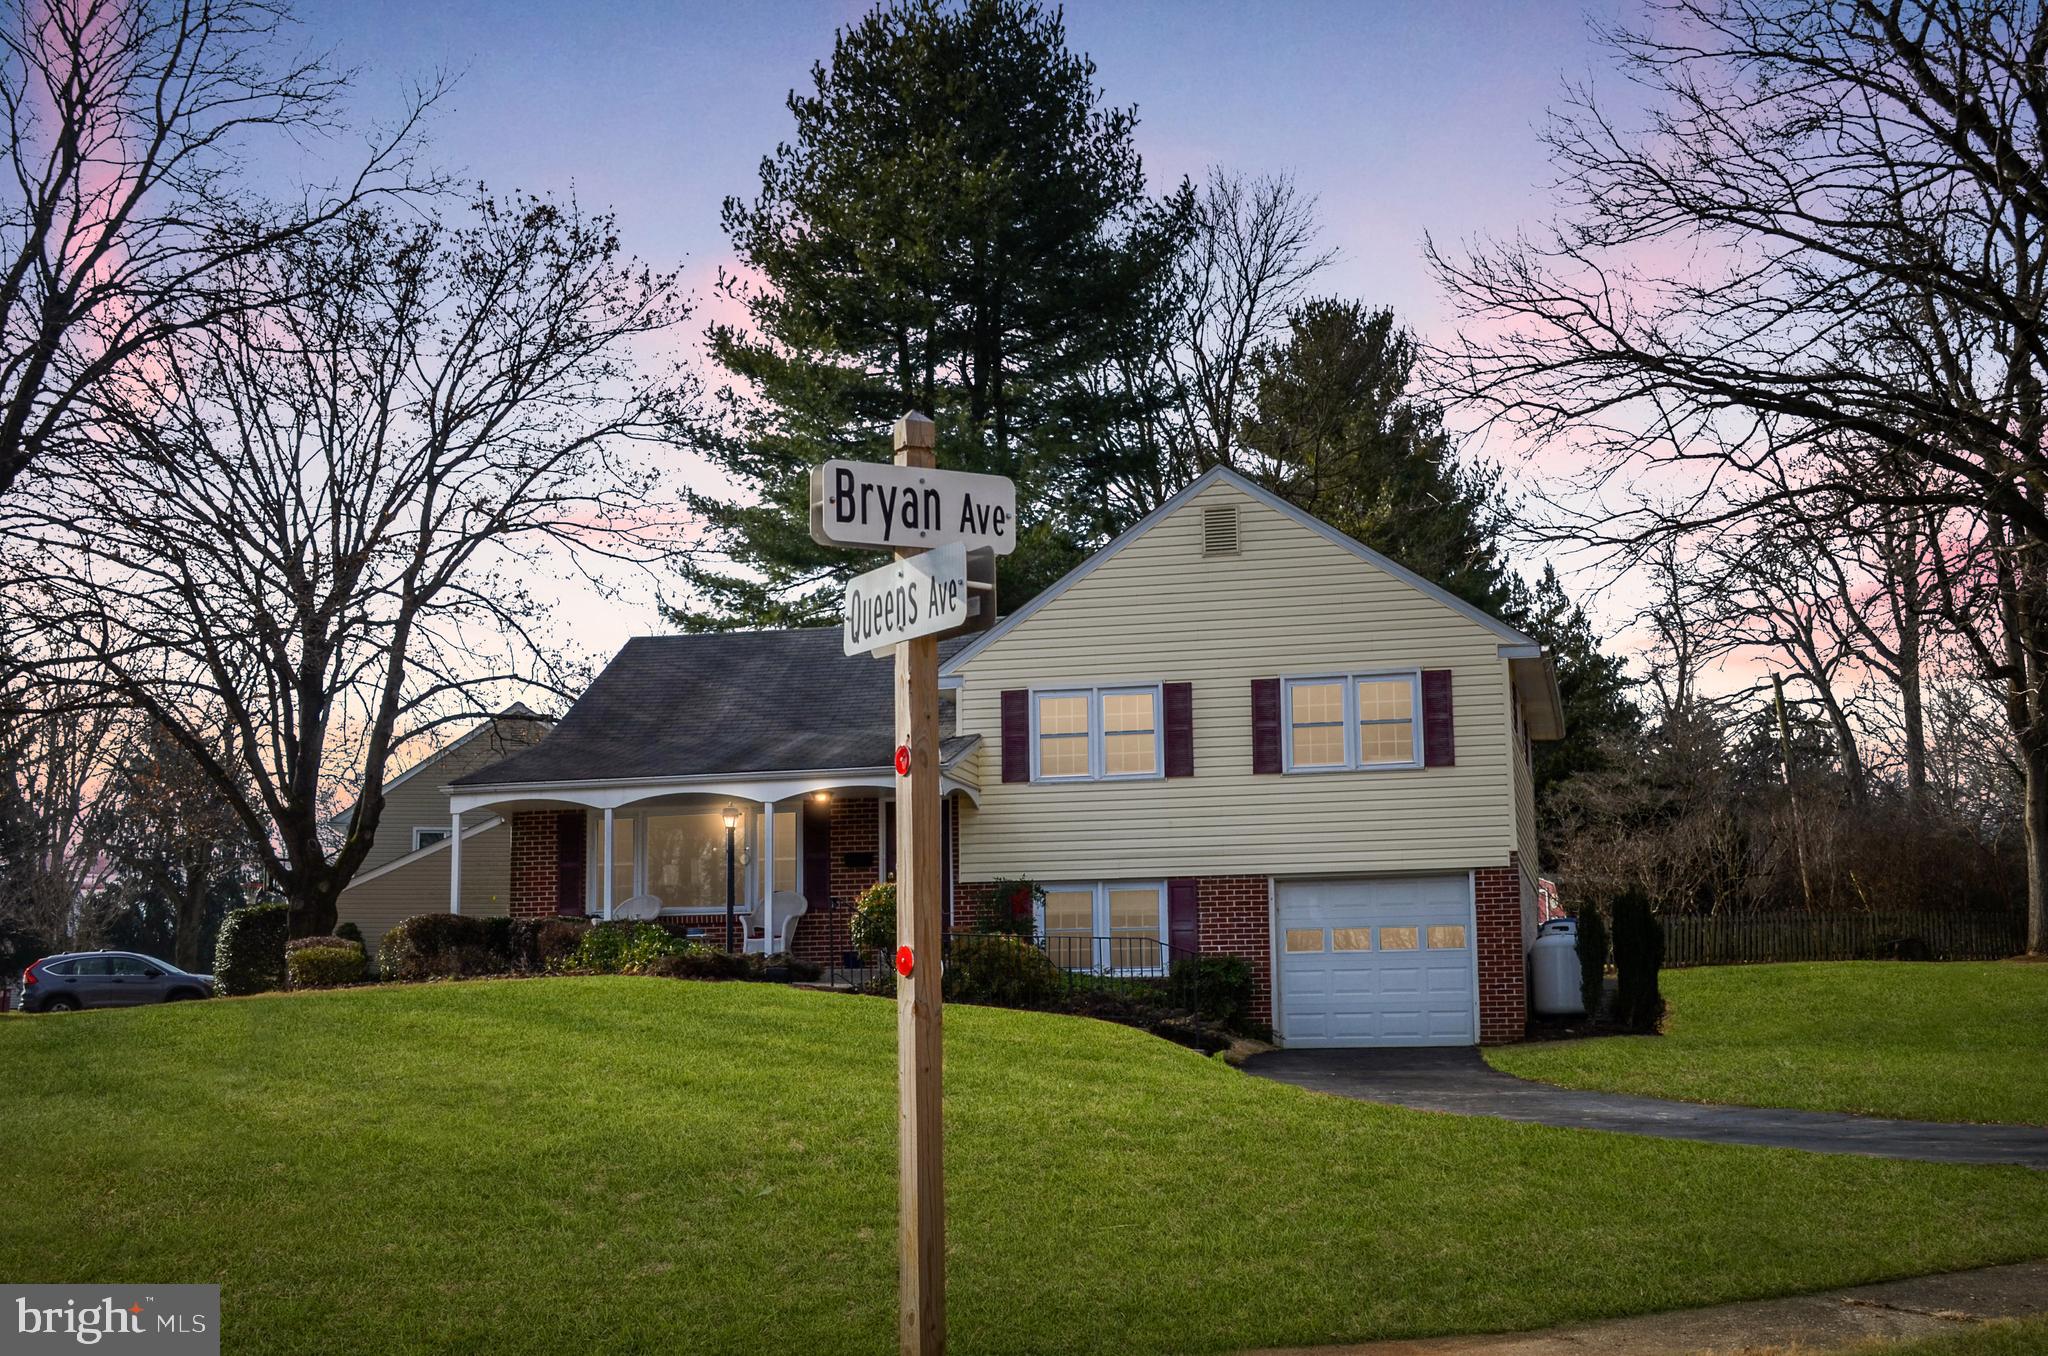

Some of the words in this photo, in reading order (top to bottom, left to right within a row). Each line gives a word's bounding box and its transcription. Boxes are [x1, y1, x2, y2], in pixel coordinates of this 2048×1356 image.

[835, 467, 941, 541] Bryan
[959, 492, 1006, 536] Ave
[850, 581, 918, 644] Queens
[928, 575, 957, 619] Ave
